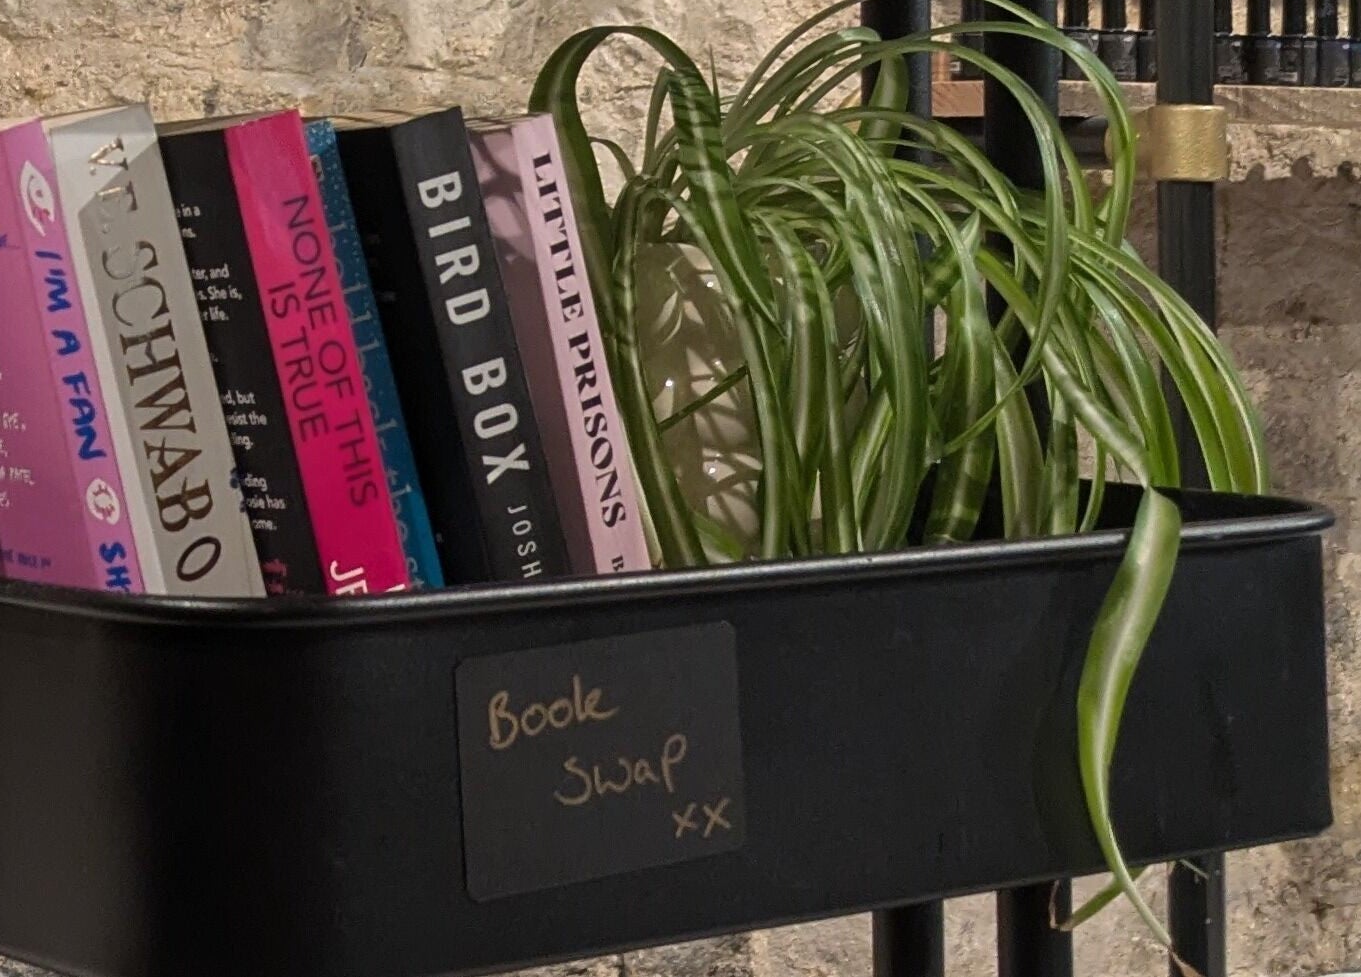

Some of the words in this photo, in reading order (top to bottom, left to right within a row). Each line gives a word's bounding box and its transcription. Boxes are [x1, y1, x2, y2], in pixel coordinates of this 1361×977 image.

[35, 249, 71, 313] I'M
[207, 285, 228, 300] She
[209, 263, 229, 279] and
[268, 283, 301, 319] IS
[416, 170, 491, 325] BIRD
[461, 357, 530, 484] BOX
[52, 329, 81, 356] A
[282, 196, 337, 328] NONE
[318, 340, 354, 399] OF
[338, 413, 378, 508] THIS
[533, 152, 584, 322] LITTLE
[568, 332, 627, 528] PRISONS
[235, 390, 256, 405] but
[280, 332, 328, 443] TRUE
[62, 374, 106, 462] FAN
[248, 410, 268, 426] the
[265, 494, 287, 510] has
[99, 541, 132, 592] SH
[507, 505, 542, 578] JOSH
[553, 733, 687, 805] Swap
